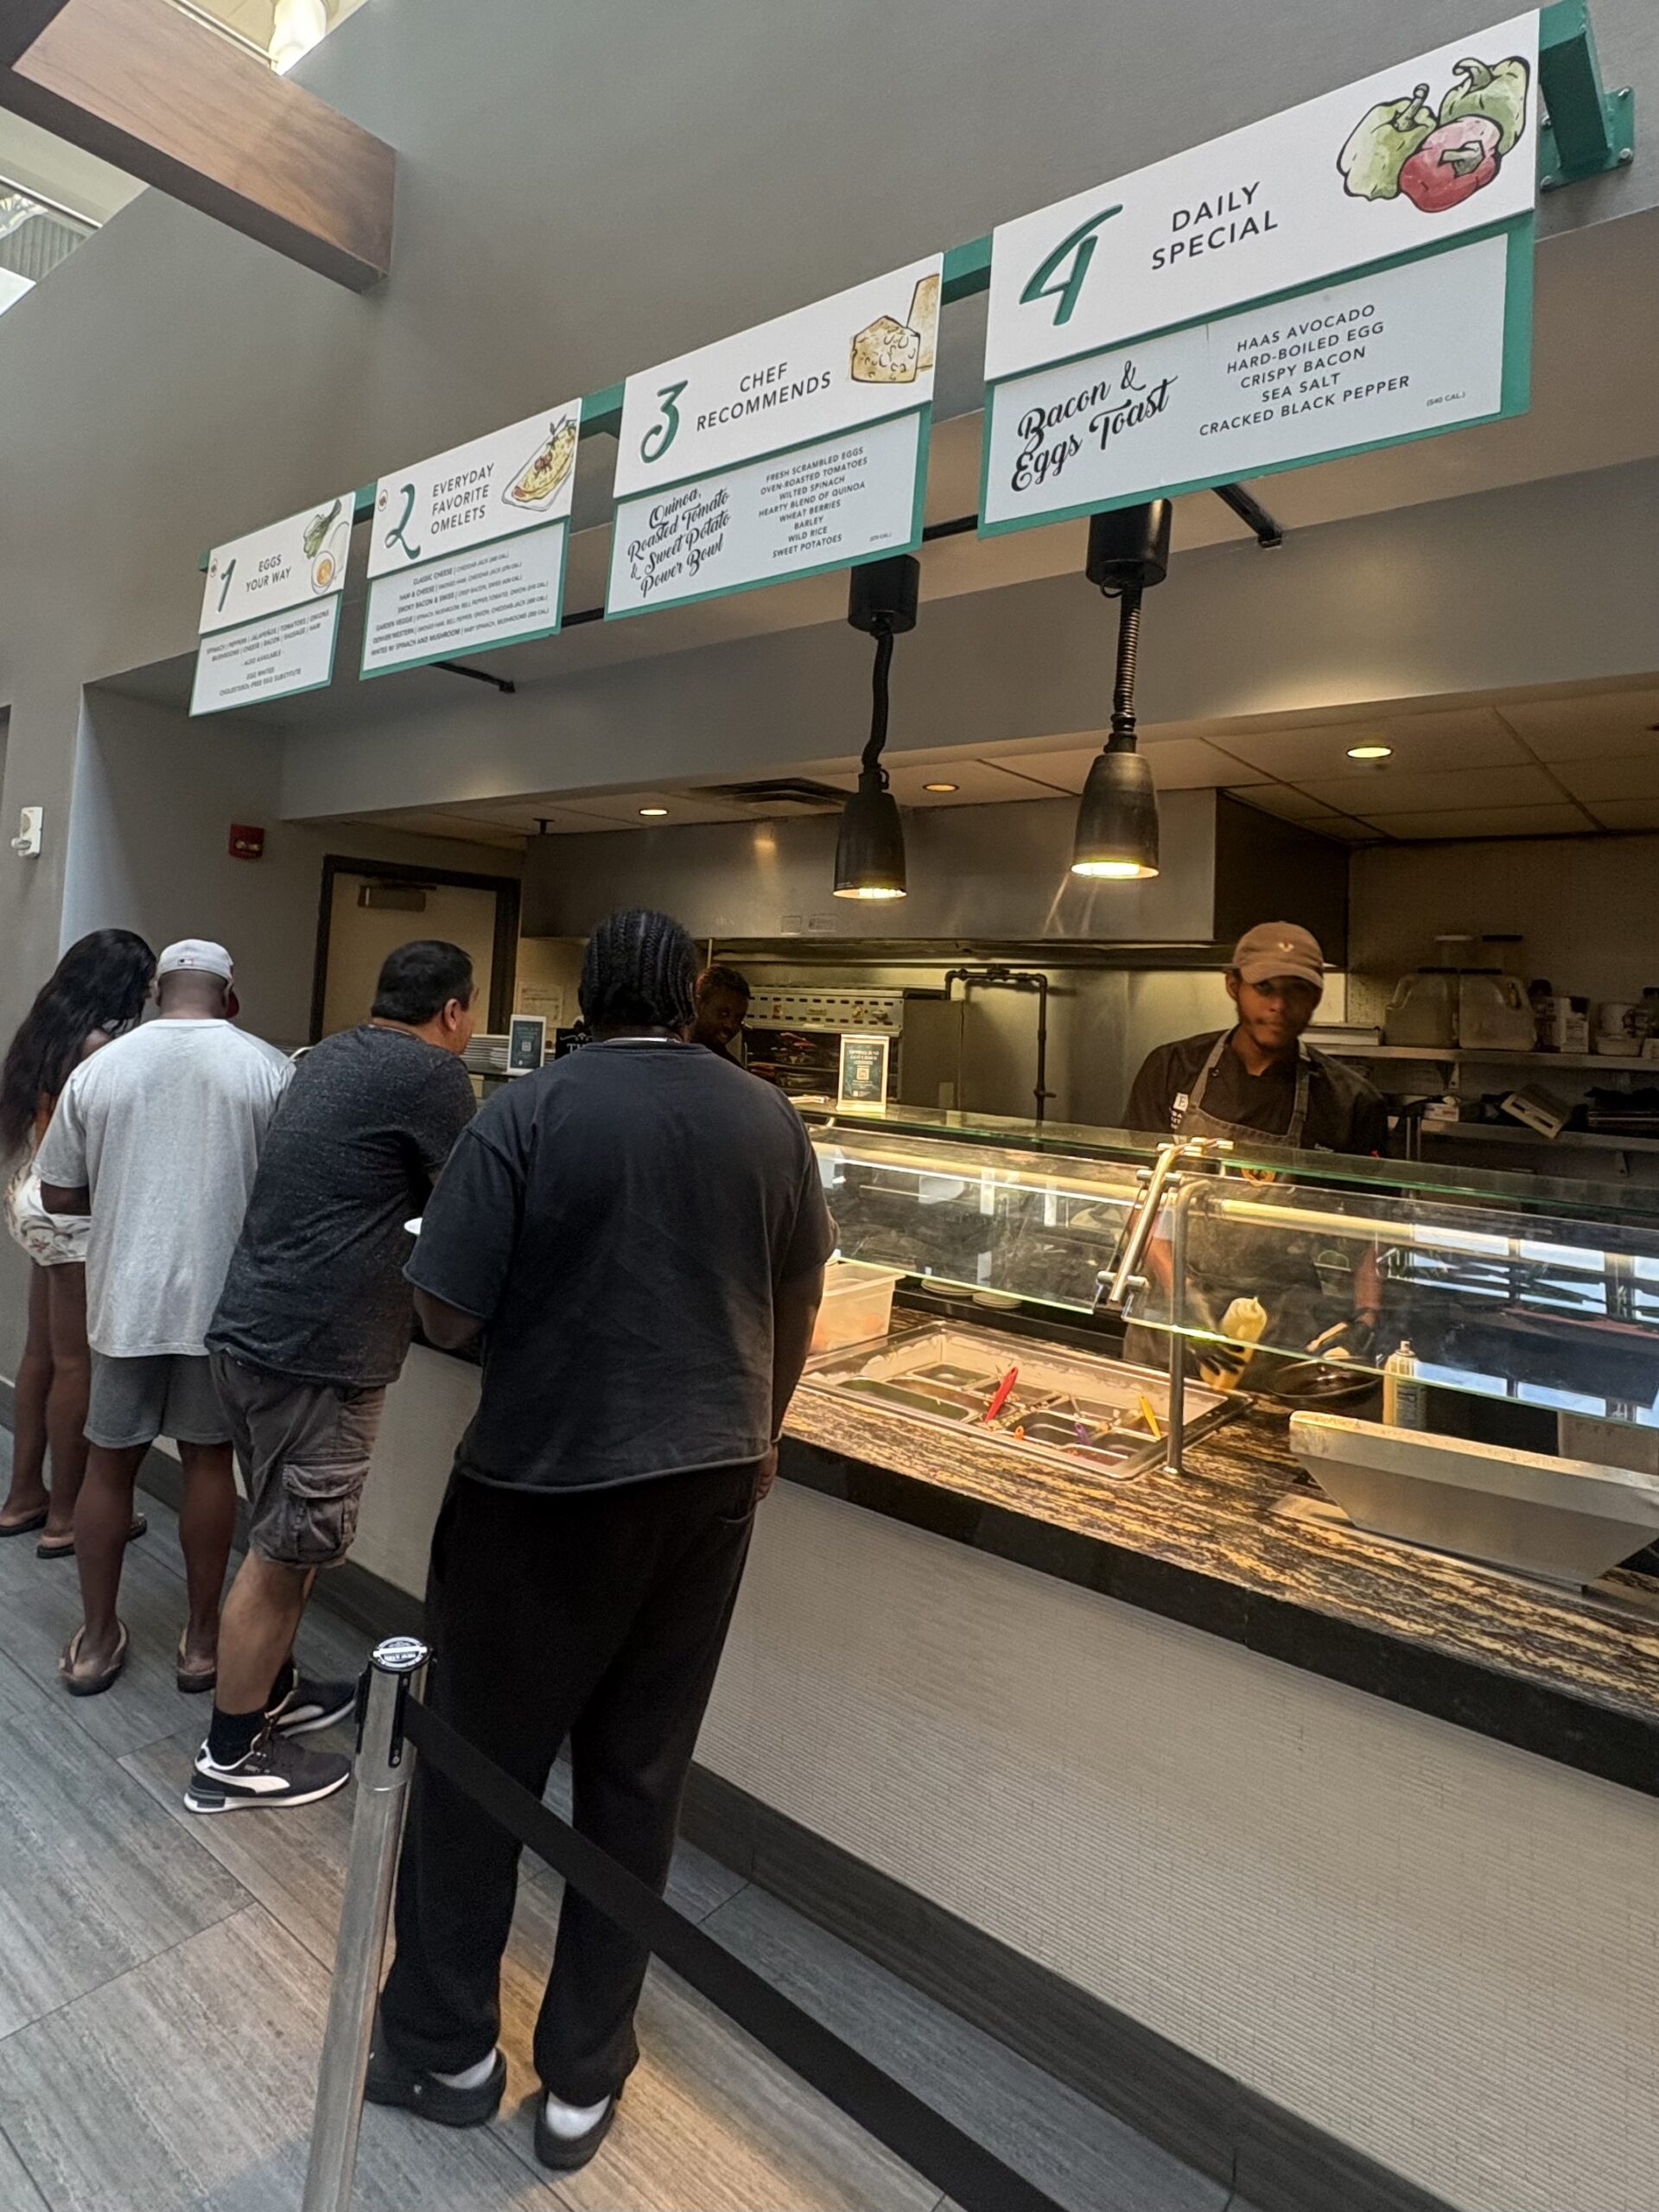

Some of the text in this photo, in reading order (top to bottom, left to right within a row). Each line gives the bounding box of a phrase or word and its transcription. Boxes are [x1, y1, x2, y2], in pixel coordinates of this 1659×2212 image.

[1173, 181, 1260, 232] DAILY
[1152, 210, 1278, 270] SPECIAL
[1020, 203, 1124, 327] 4
[1227, 321, 1383, 374] HARD-BOILED EGG
[1237, 304, 1375, 353] HAAS AVOCADO
[740, 362, 787, 392] CHEF
[1241, 346, 1365, 388] CRISPY BACON
[1262, 372, 1341, 403] SEA SALT
[640, 380, 689, 463] 3
[696, 371, 830, 432] RECOMMENDS
[1017, 360, 1146, 452] Bacon &
[1199, 375, 1409, 435] CRACKED BLACK PEPPER
[1011, 375, 1179, 492] Eggs Toast
[433, 463, 494, 498] EVERYDAY
[760, 456, 868, 495] OVEN-ROASTED TOMATOES
[766, 446, 863, 483] FRESH SCRAMBLED EGGS
[432, 484, 489, 516] FAVORITE
[759, 481, 865, 518] HEARTY BLEND OF QUINOA
[779, 475, 845, 500] WILTED SPINACH
[385, 483, 421, 560] 2
[430, 505, 486, 535] OMELETS
[627, 486, 730, 563] Roasted Tomato
[649, 488, 702, 529] Quinoa,
[779, 499, 841, 523] WHEAT BERRIES
[794, 515, 823, 531] BARLEY
[631, 509, 731, 580] & Sweet Potato
[772, 533, 842, 558] SWEET POTATOES
[788, 525, 828, 543] WILD RICE
[246, 567, 291, 592] YOUR WAY
[258, 554, 282, 573] EGGS
[640, 533, 723, 598] Power Bowl
[218, 558, 237, 613] 1
